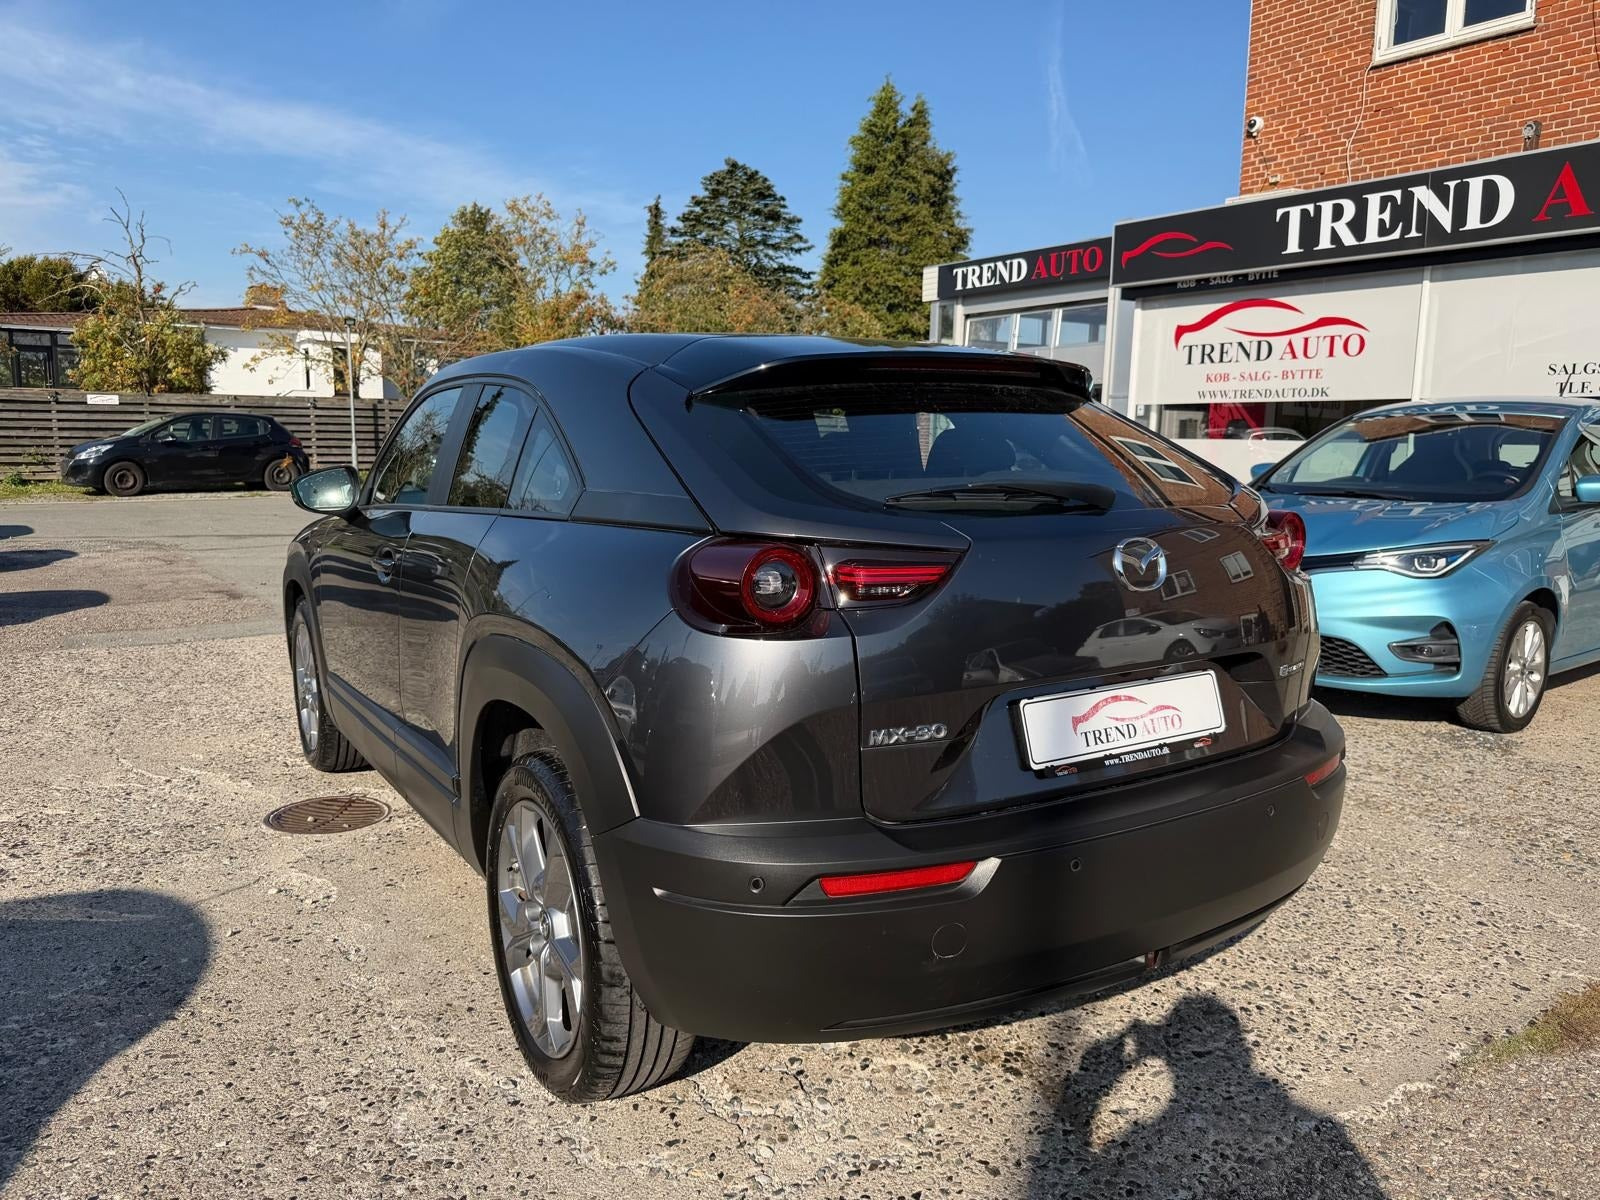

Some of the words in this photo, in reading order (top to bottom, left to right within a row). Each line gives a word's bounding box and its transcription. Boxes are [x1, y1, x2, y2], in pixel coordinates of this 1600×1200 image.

[1275, 174, 1515, 255] TREND
[953, 257, 1028, 291] TREND
[1031, 246, 1104, 280] AUTO
[1208, 275, 1233, 285] SALG
[1248, 270, 1279, 281] BYTTE
[1183, 340, 1273, 365] TREND
[1279, 333, 1366, 361] AUTO
[1205, 372, 1230, 383] KØB
[1238, 370, 1271, 382] SALG
[1281, 368, 1323, 381] BYTTE
[1197, 387, 1330, 400] WWW.TRENDAUTO.DK
[1556, 381, 1593, 394] TLF.
[869, 723, 947, 746] MX-30
[1080, 723, 1137, 748] TREND
[1141, 713, 1183, 738] AUTO
[1104, 747, 1170, 767] www.TRENDAUTO.dk
